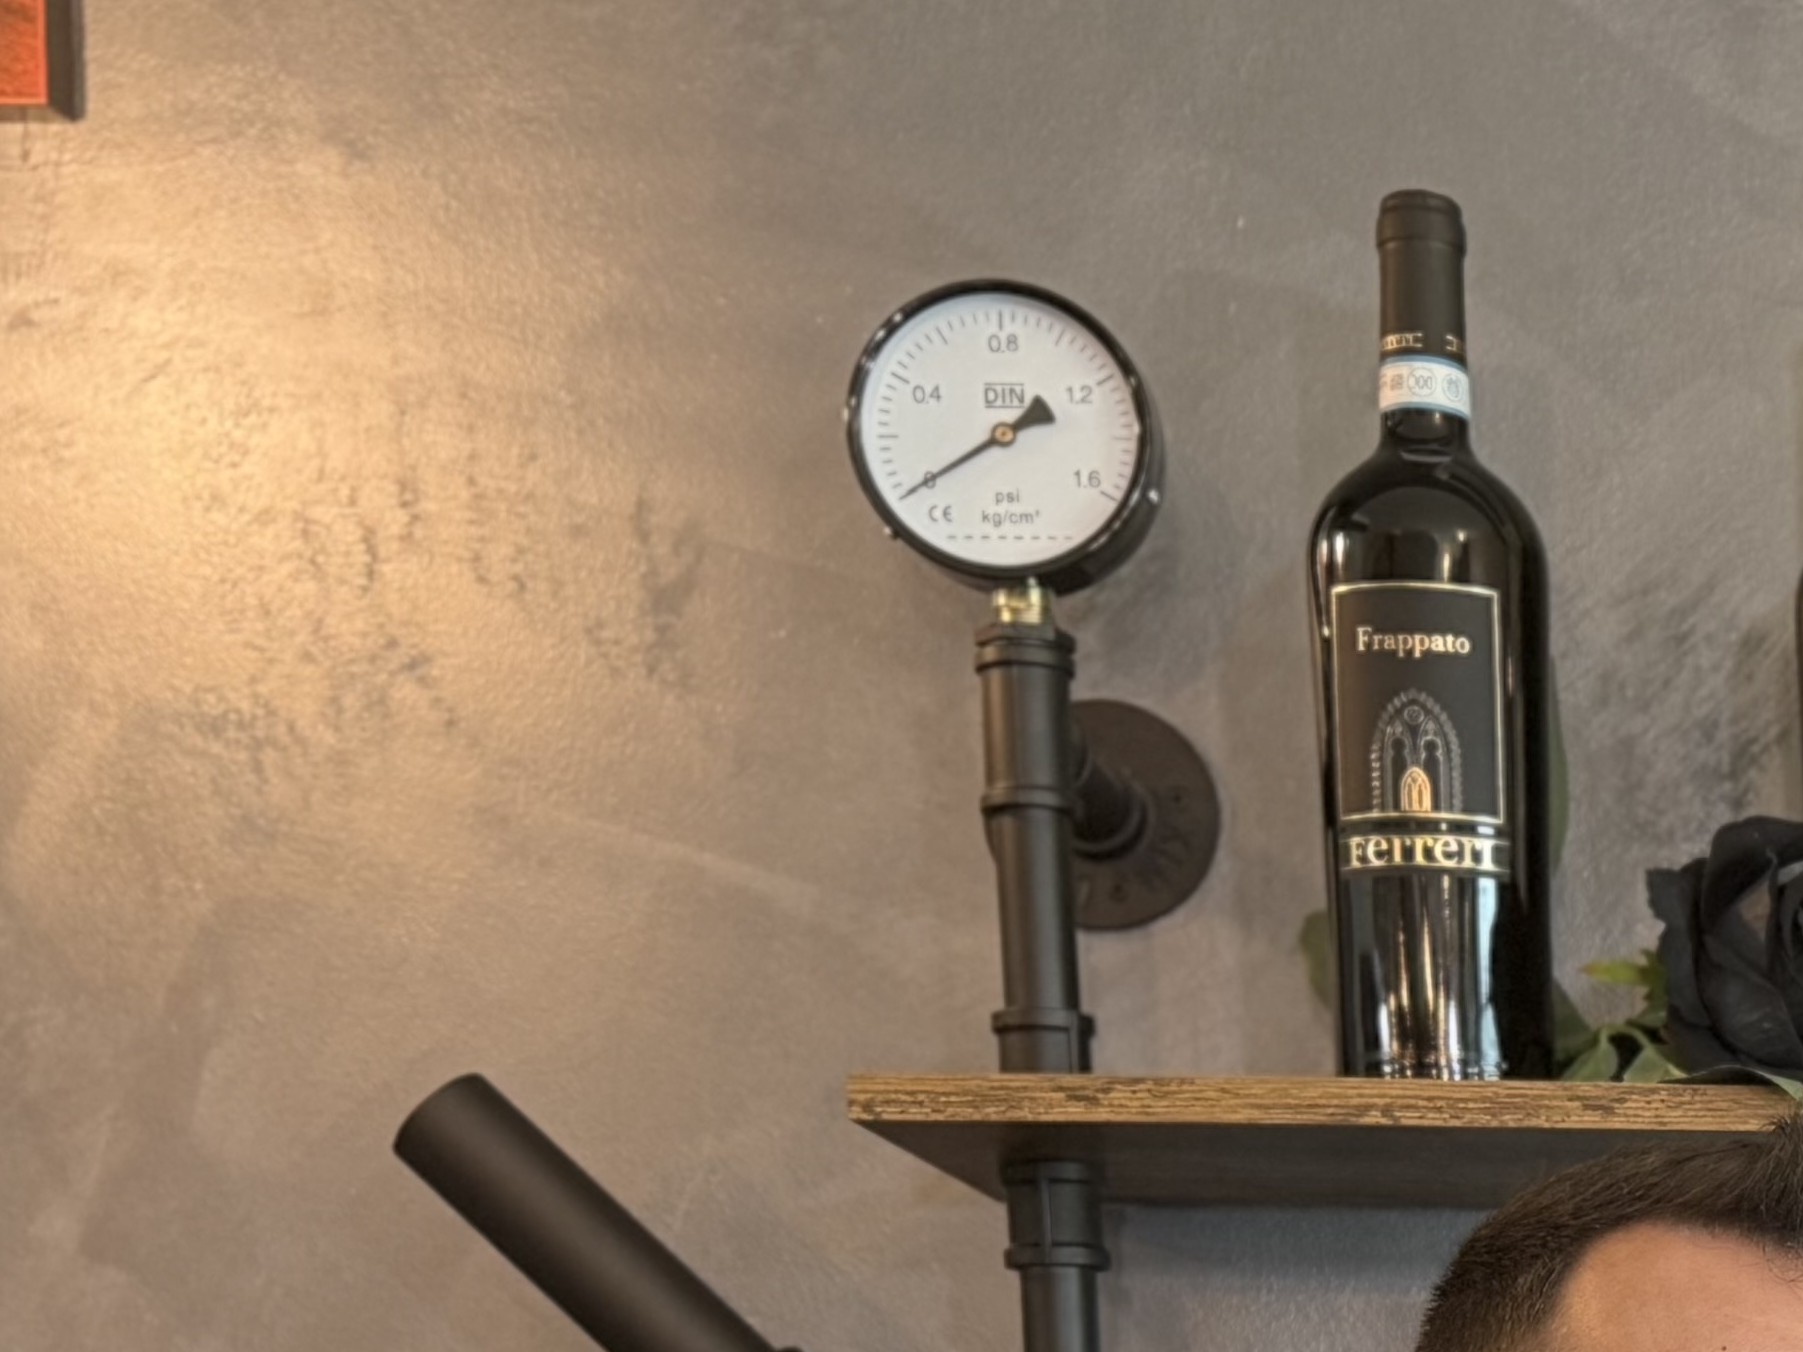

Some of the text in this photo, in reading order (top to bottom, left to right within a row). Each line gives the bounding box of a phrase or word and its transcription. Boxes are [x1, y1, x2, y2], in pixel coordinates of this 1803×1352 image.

[987, 333, 1019, 354] 0.8
[911, 384, 943, 404] 0.4
[983, 385, 1026, 406] DIN
[1065, 384, 1094, 405] 1.2
[1072, 469, 1102, 489] 1.6
[994, 488, 1021, 506] psi
[1355, 626, 1472, 659] Frappato
